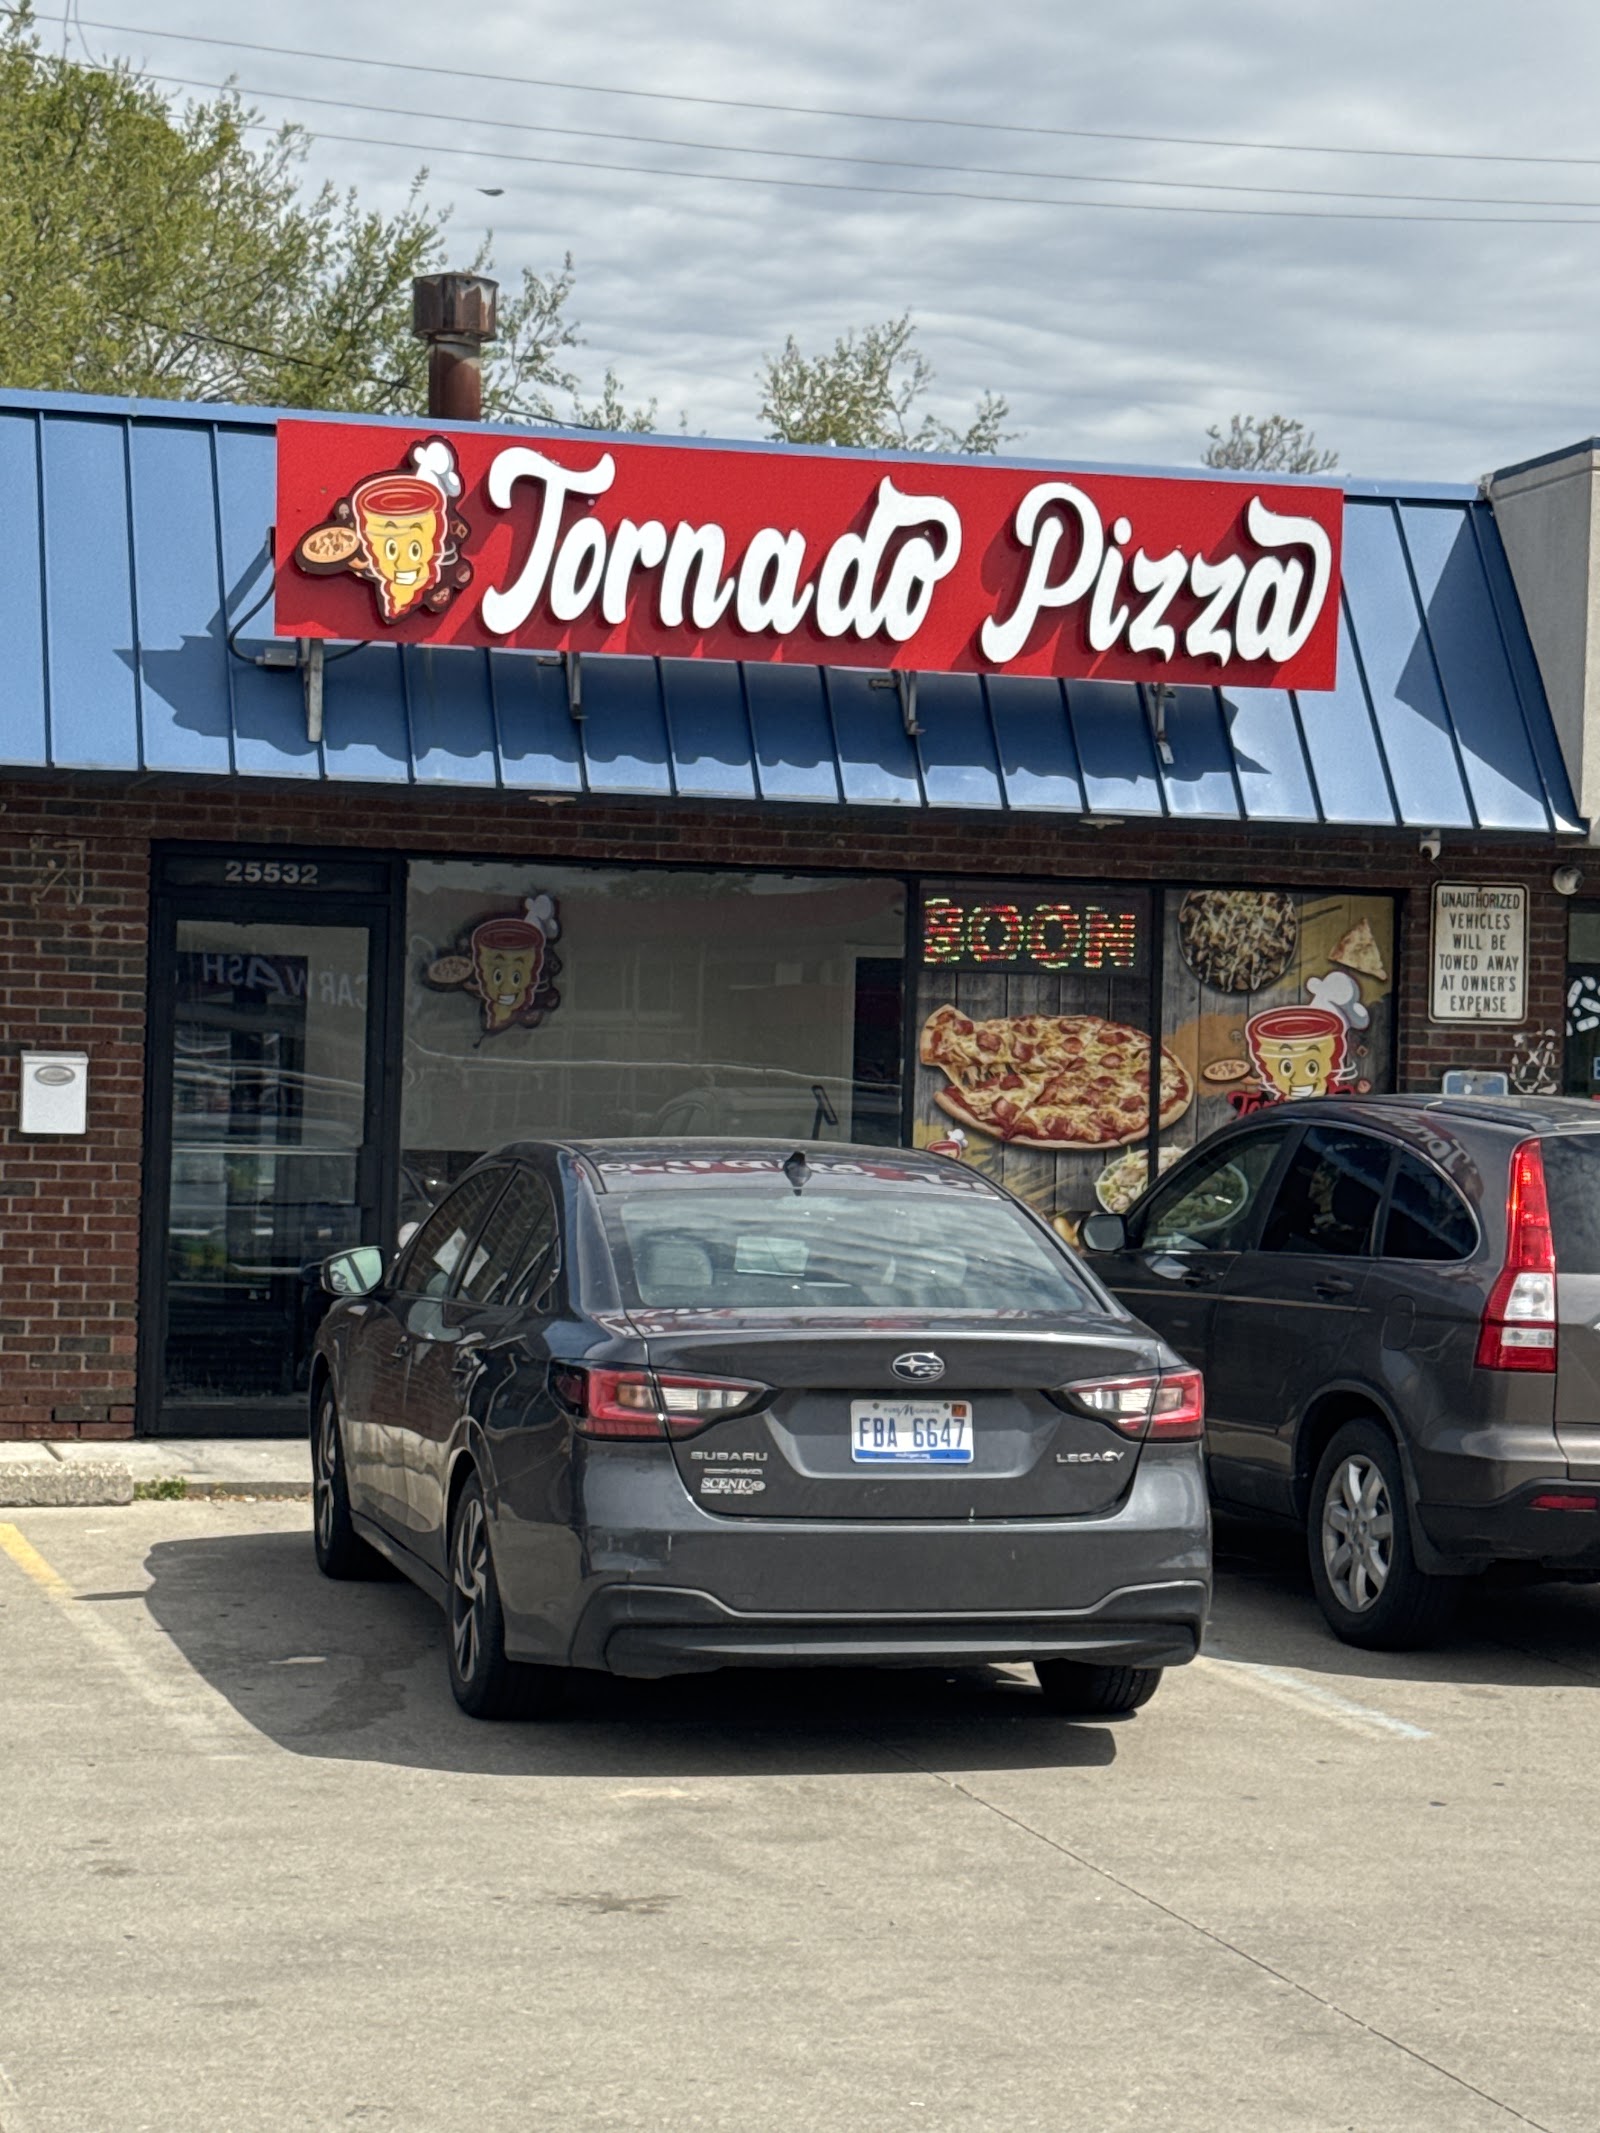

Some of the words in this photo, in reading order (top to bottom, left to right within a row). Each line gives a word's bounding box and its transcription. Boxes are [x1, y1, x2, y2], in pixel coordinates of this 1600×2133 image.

[481, 447, 963, 643] Tornado
[980, 481, 1332, 667] Pizza
[225, 860, 319, 884] 25532
[1441, 892, 1520, 910] UNAUTHORIZED
[1449, 913, 1511, 930] VEHICLES
[1452, 934, 1483, 951] WILL
[1491, 935, 1507, 951] BE
[1439, 954, 1478, 971] TOWED
[1486, 955, 1520, 971] AWAY
[1441, 975, 1456, 991] AT
[1461, 976, 1517, 993] OWNER'S
[1449, 996, 1508, 1013] EXPENSE
[859, 1417, 898, 1448] FBA
[912, 1417, 966, 1448] 6647
[690, 1451, 768, 1462] SUBARU
[1056, 1450, 1125, 1463] LEGACY
[701, 1477, 753, 1490] SCENIC
